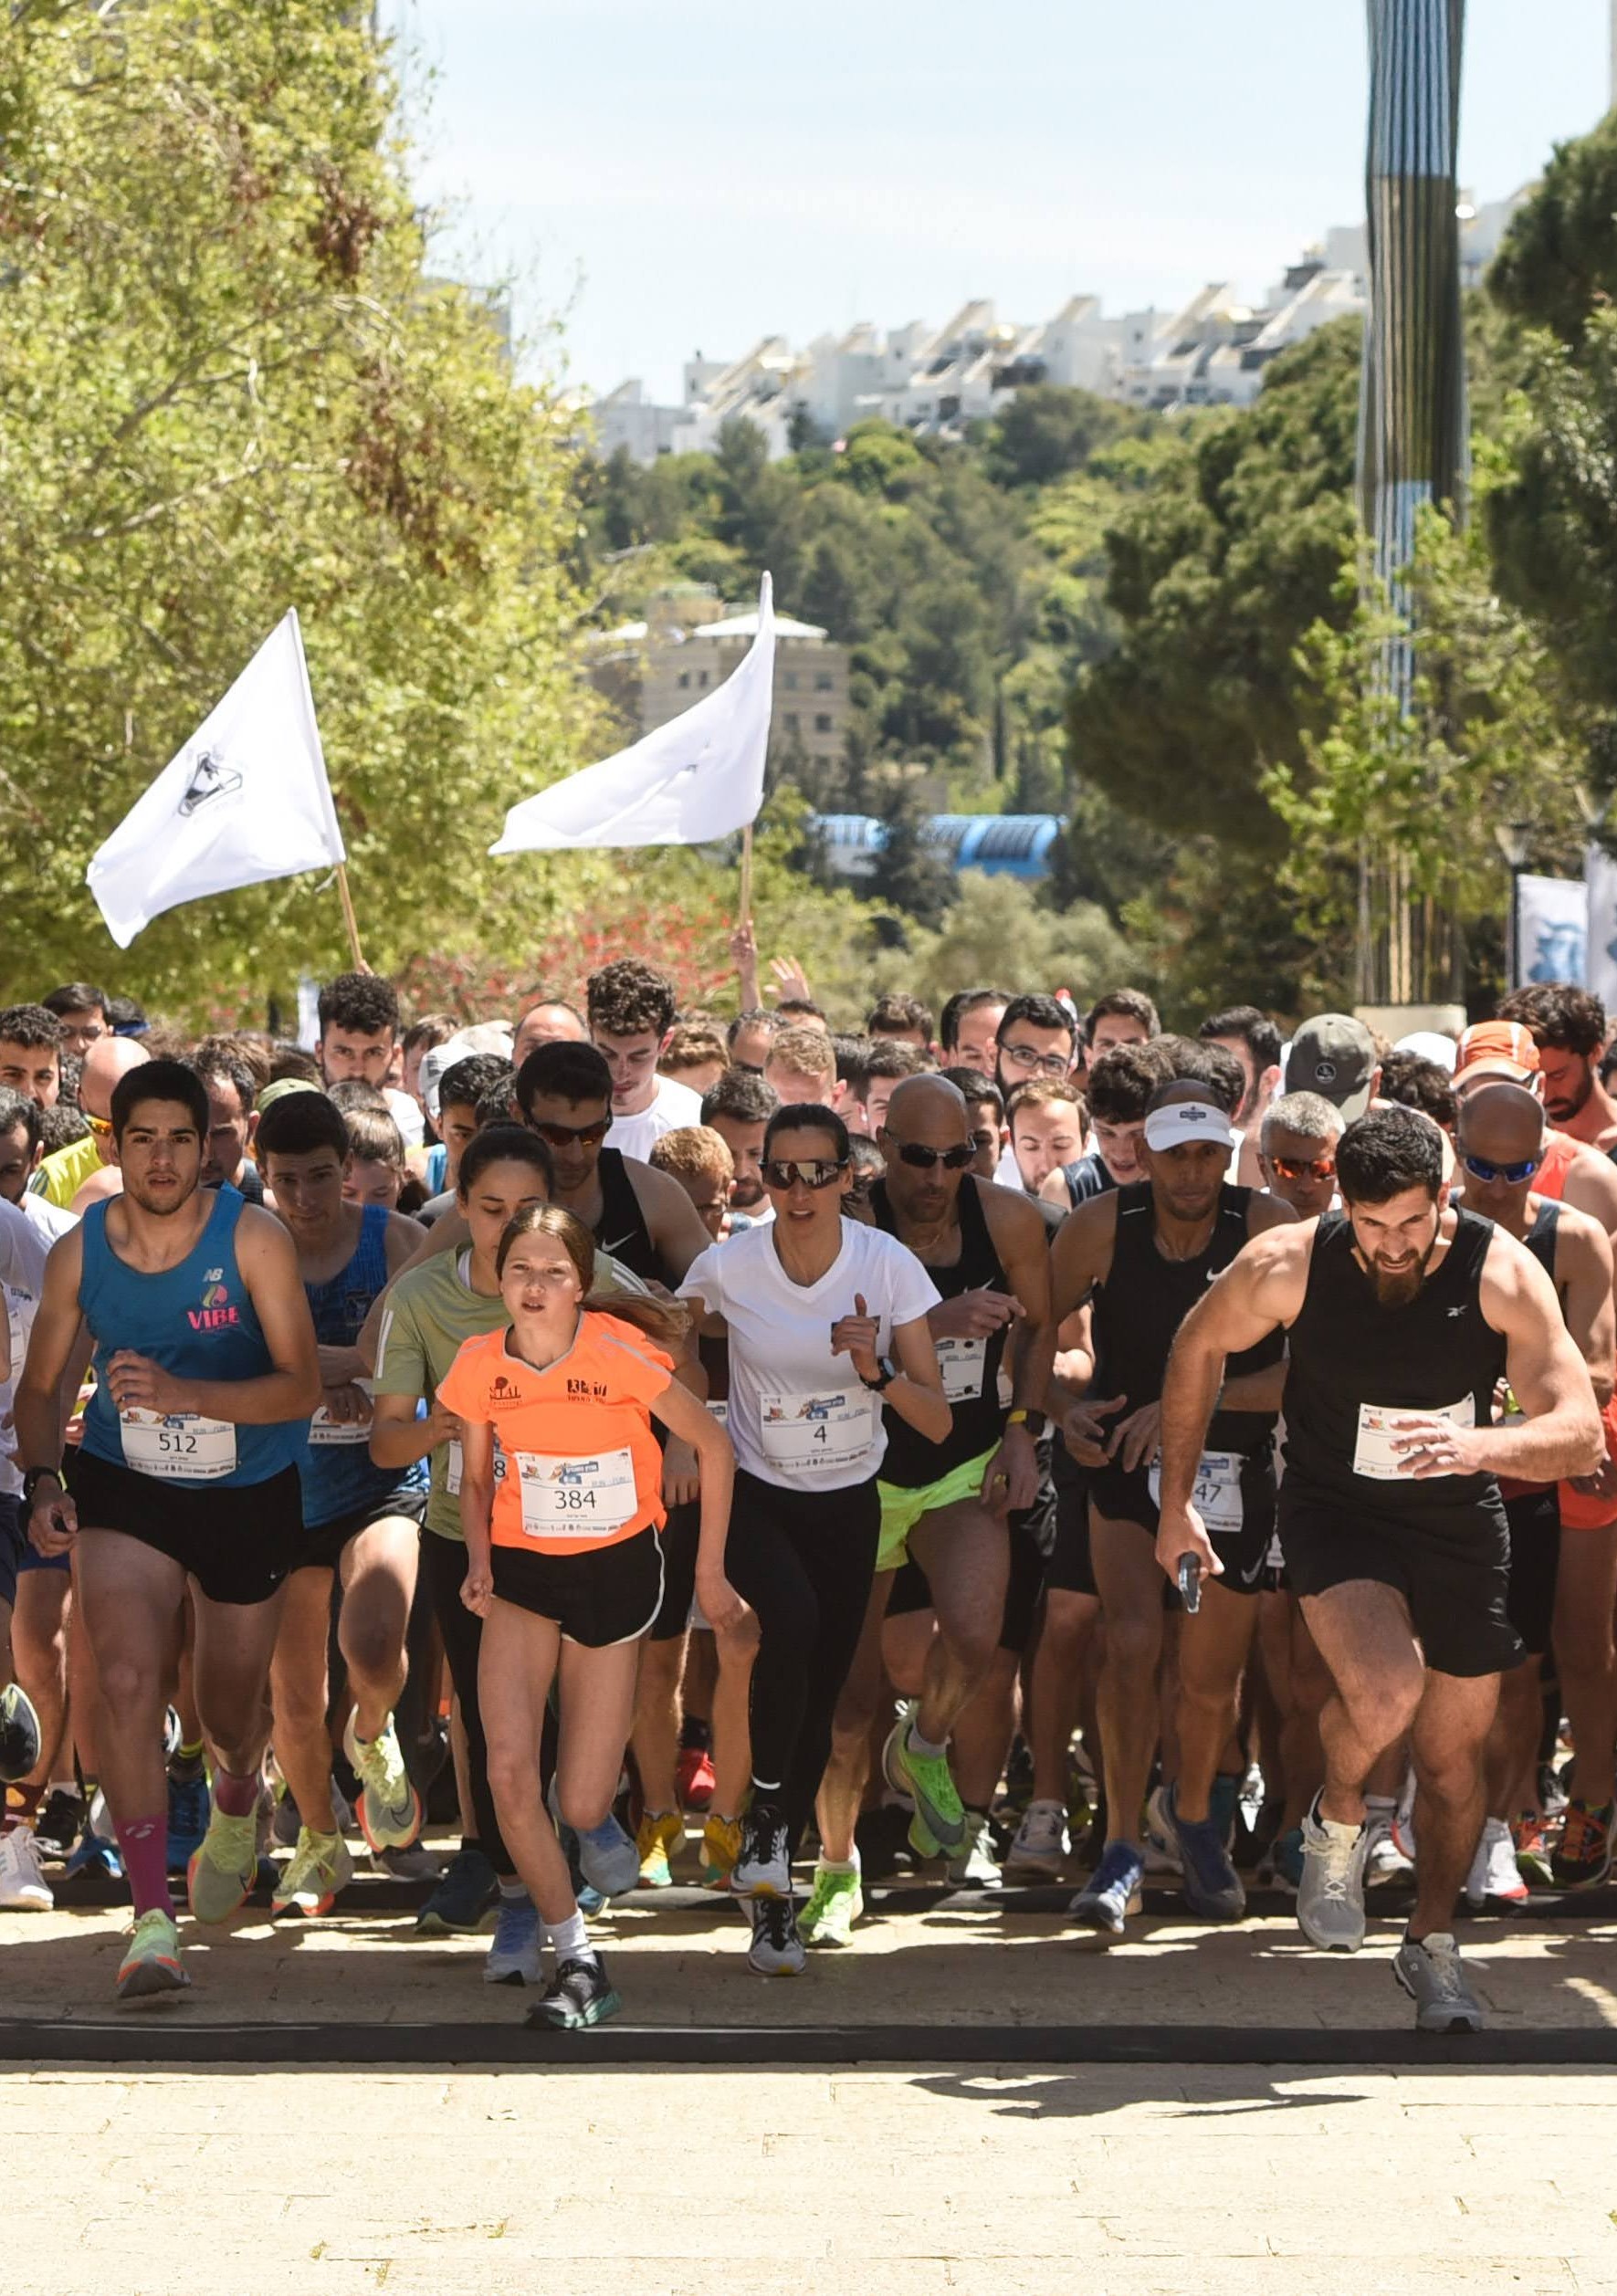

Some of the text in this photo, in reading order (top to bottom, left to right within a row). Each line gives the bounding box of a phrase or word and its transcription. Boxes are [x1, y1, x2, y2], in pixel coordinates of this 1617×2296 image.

[187, 1307, 239, 1329] VIBE
[159, 1433, 198, 1453] 512
[814, 1425, 827, 1443] 4
[554, 1490, 596, 1509] 384
